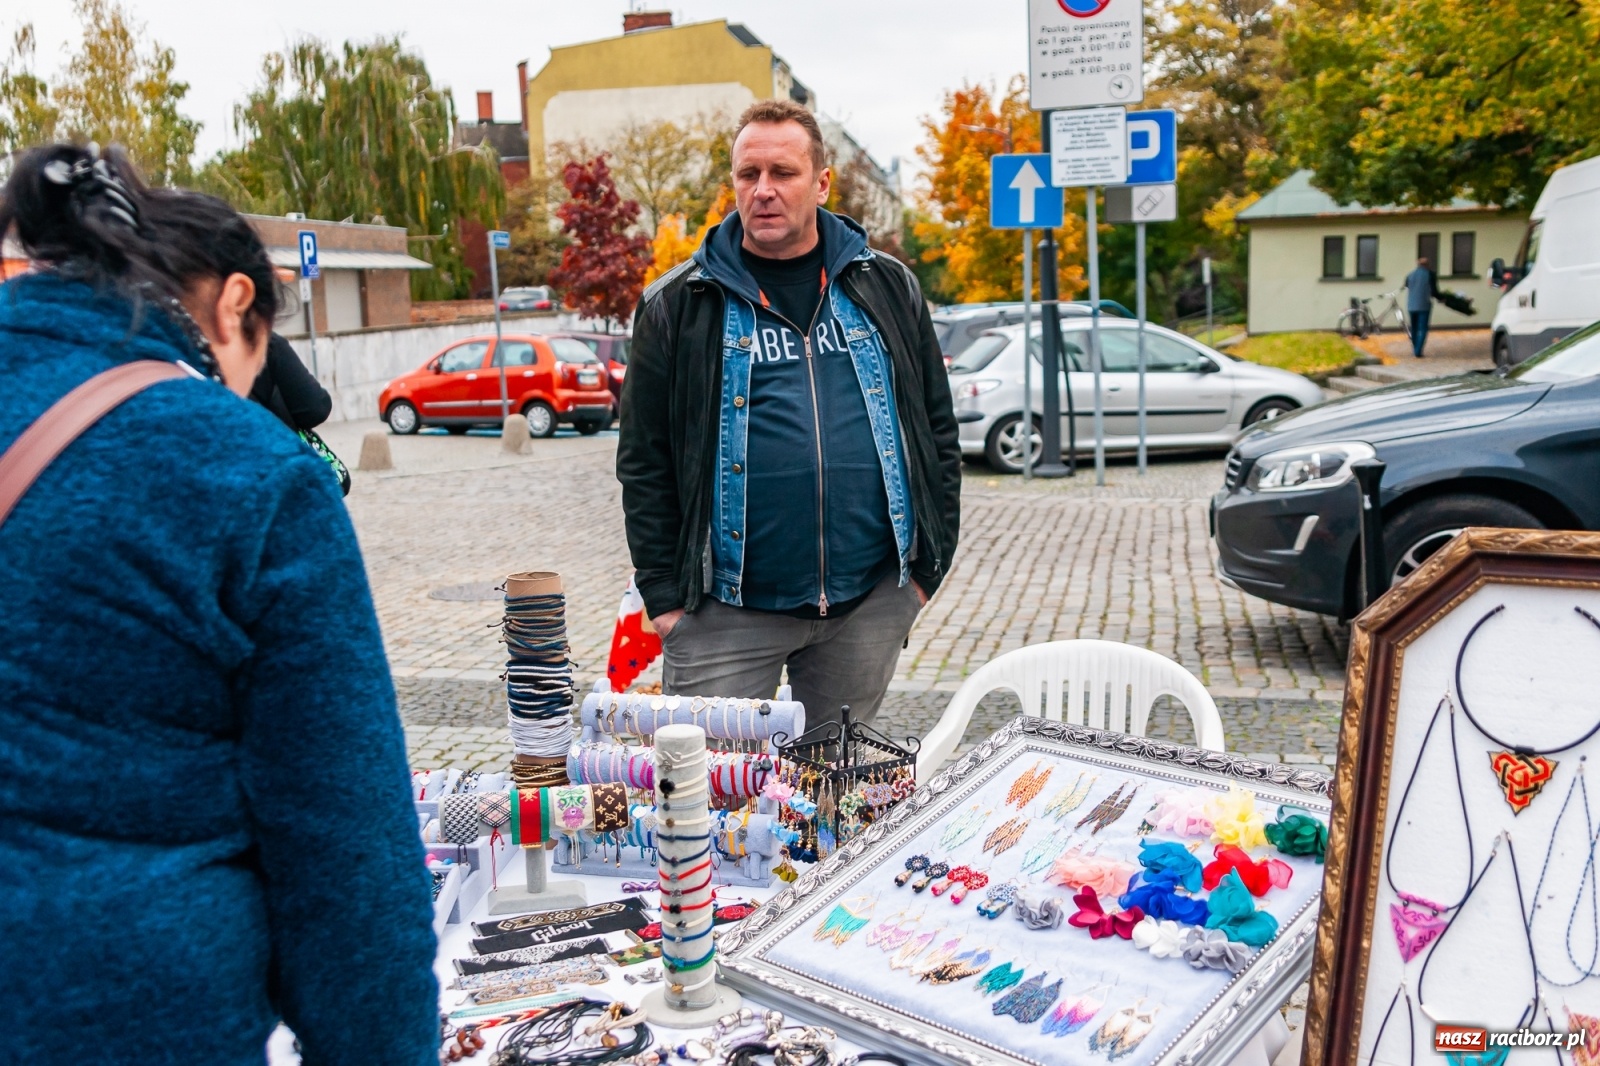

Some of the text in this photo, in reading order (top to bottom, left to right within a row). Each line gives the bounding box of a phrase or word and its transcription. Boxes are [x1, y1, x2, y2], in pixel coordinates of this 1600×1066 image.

[1073, 20, 1130, 32] ograniczony
[1037, 37, 1049, 45] do
[1069, 56, 1102, 64] sobota
[1128, 119, 1161, 177] P
[302, 234, 315, 266] P
[531, 920, 594, 943] Gibson
